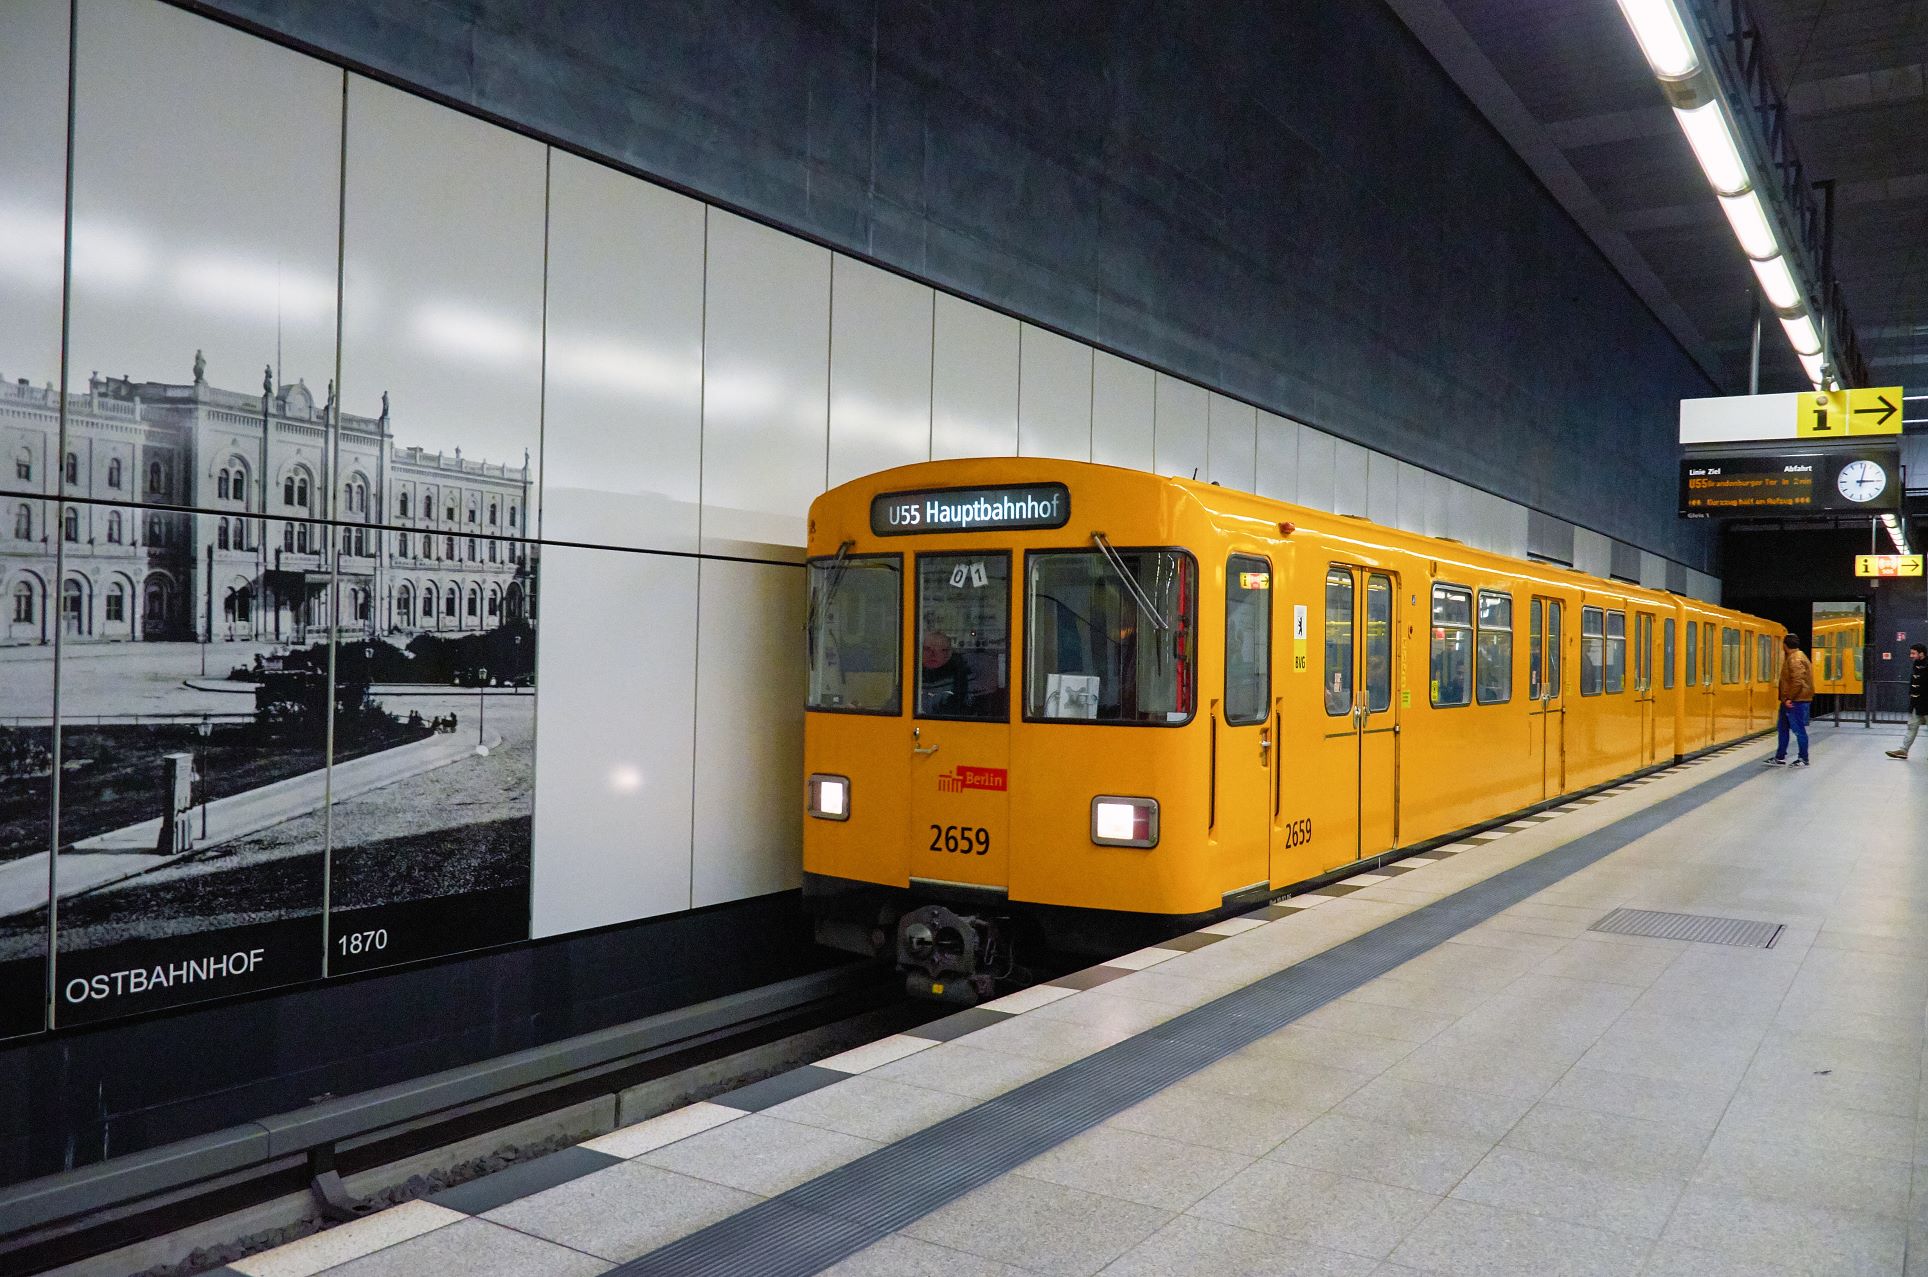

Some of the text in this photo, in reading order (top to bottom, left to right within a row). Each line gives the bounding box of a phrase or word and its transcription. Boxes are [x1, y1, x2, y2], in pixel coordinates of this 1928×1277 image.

[1784, 465, 1812, 473] Abfahrt
[1689, 479, 1708, 489] U55
[889, 494, 1059, 527] U55 Hauptbahnhof
[1294, 655, 1306, 670] BVG
[965, 771, 1002, 786] Berlin
[929, 824, 990, 855] 2659
[1285, 818, 1312, 849] 2659
[337, 929, 389, 956] 1870
[65, 949, 265, 1003] OSTBAHNHOF
